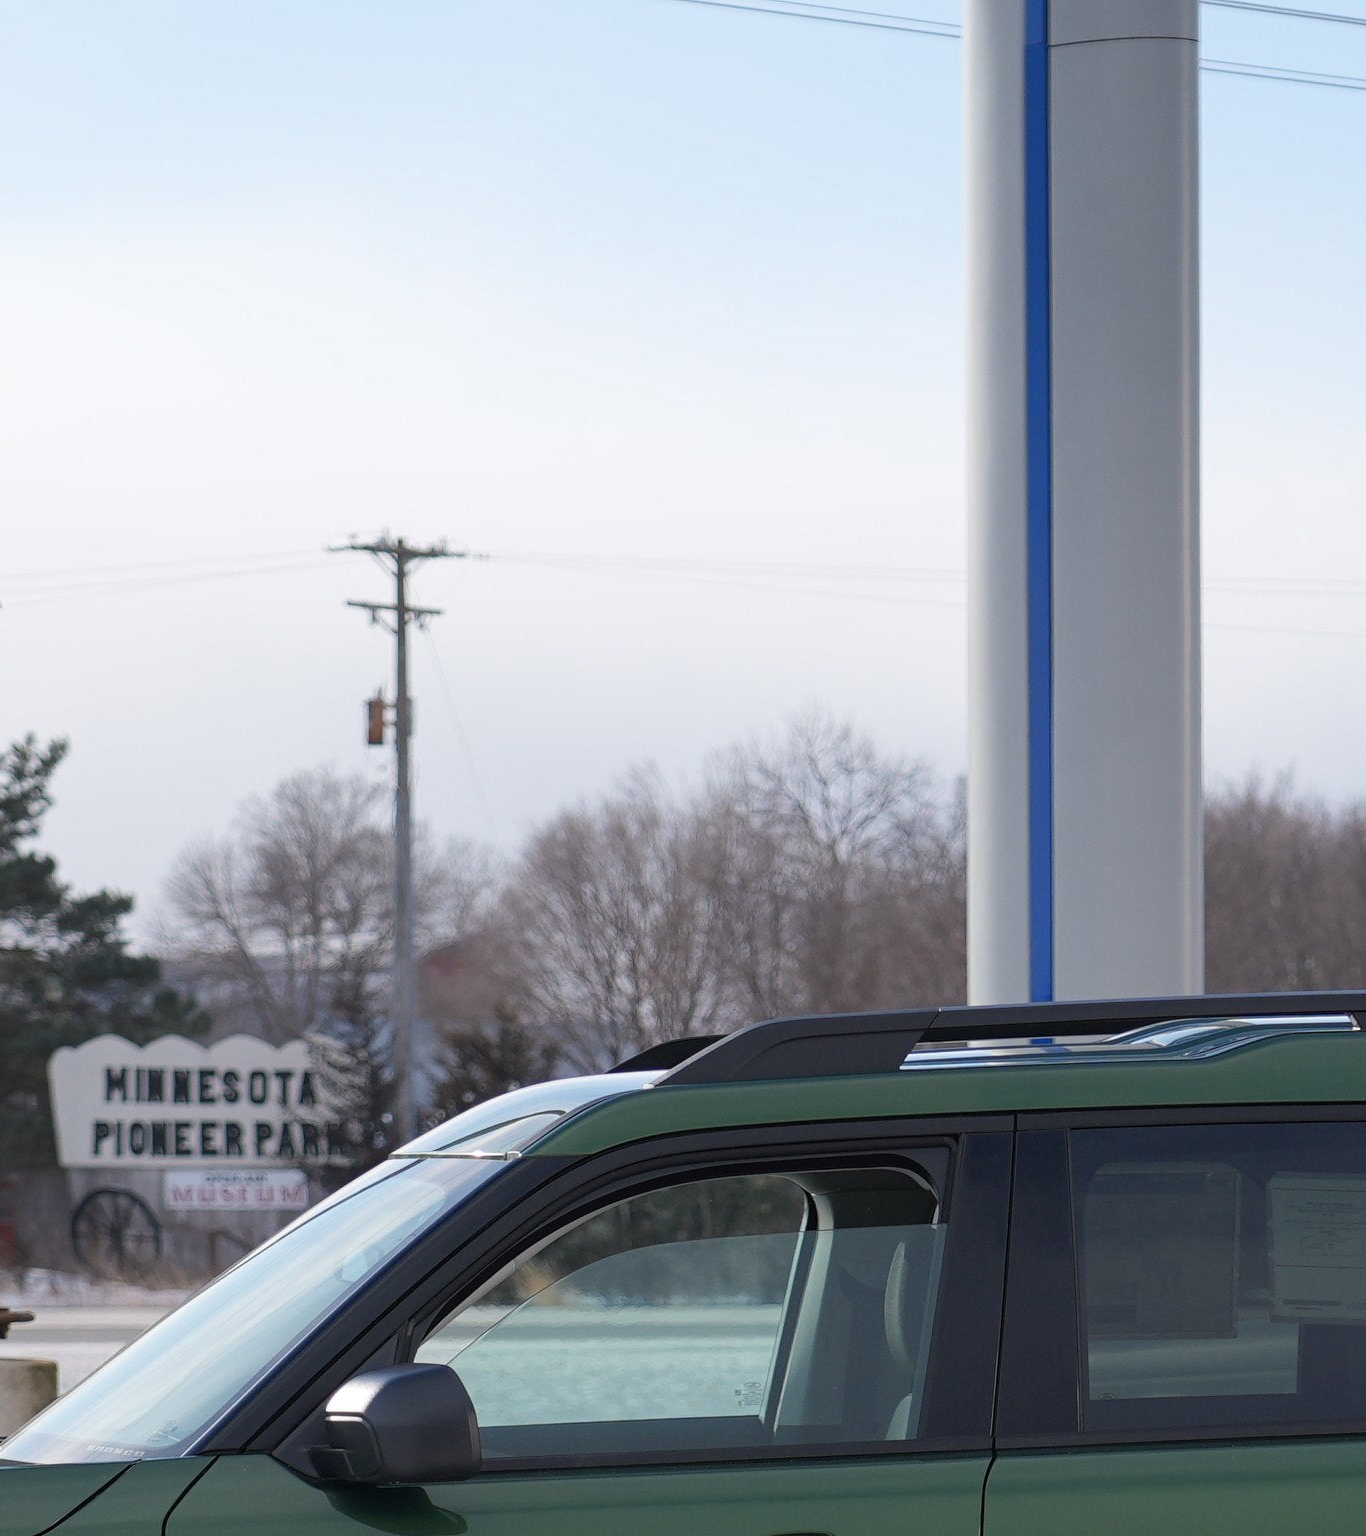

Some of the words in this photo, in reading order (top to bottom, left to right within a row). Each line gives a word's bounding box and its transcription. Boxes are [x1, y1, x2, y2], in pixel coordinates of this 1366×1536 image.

[103, 1067, 318, 1105] MINNESOTA
[92, 1122, 243, 1157] PIONEER
[254, 1122, 345, 1158] PARK
[172, 1183, 308, 1203] MUSEUM
